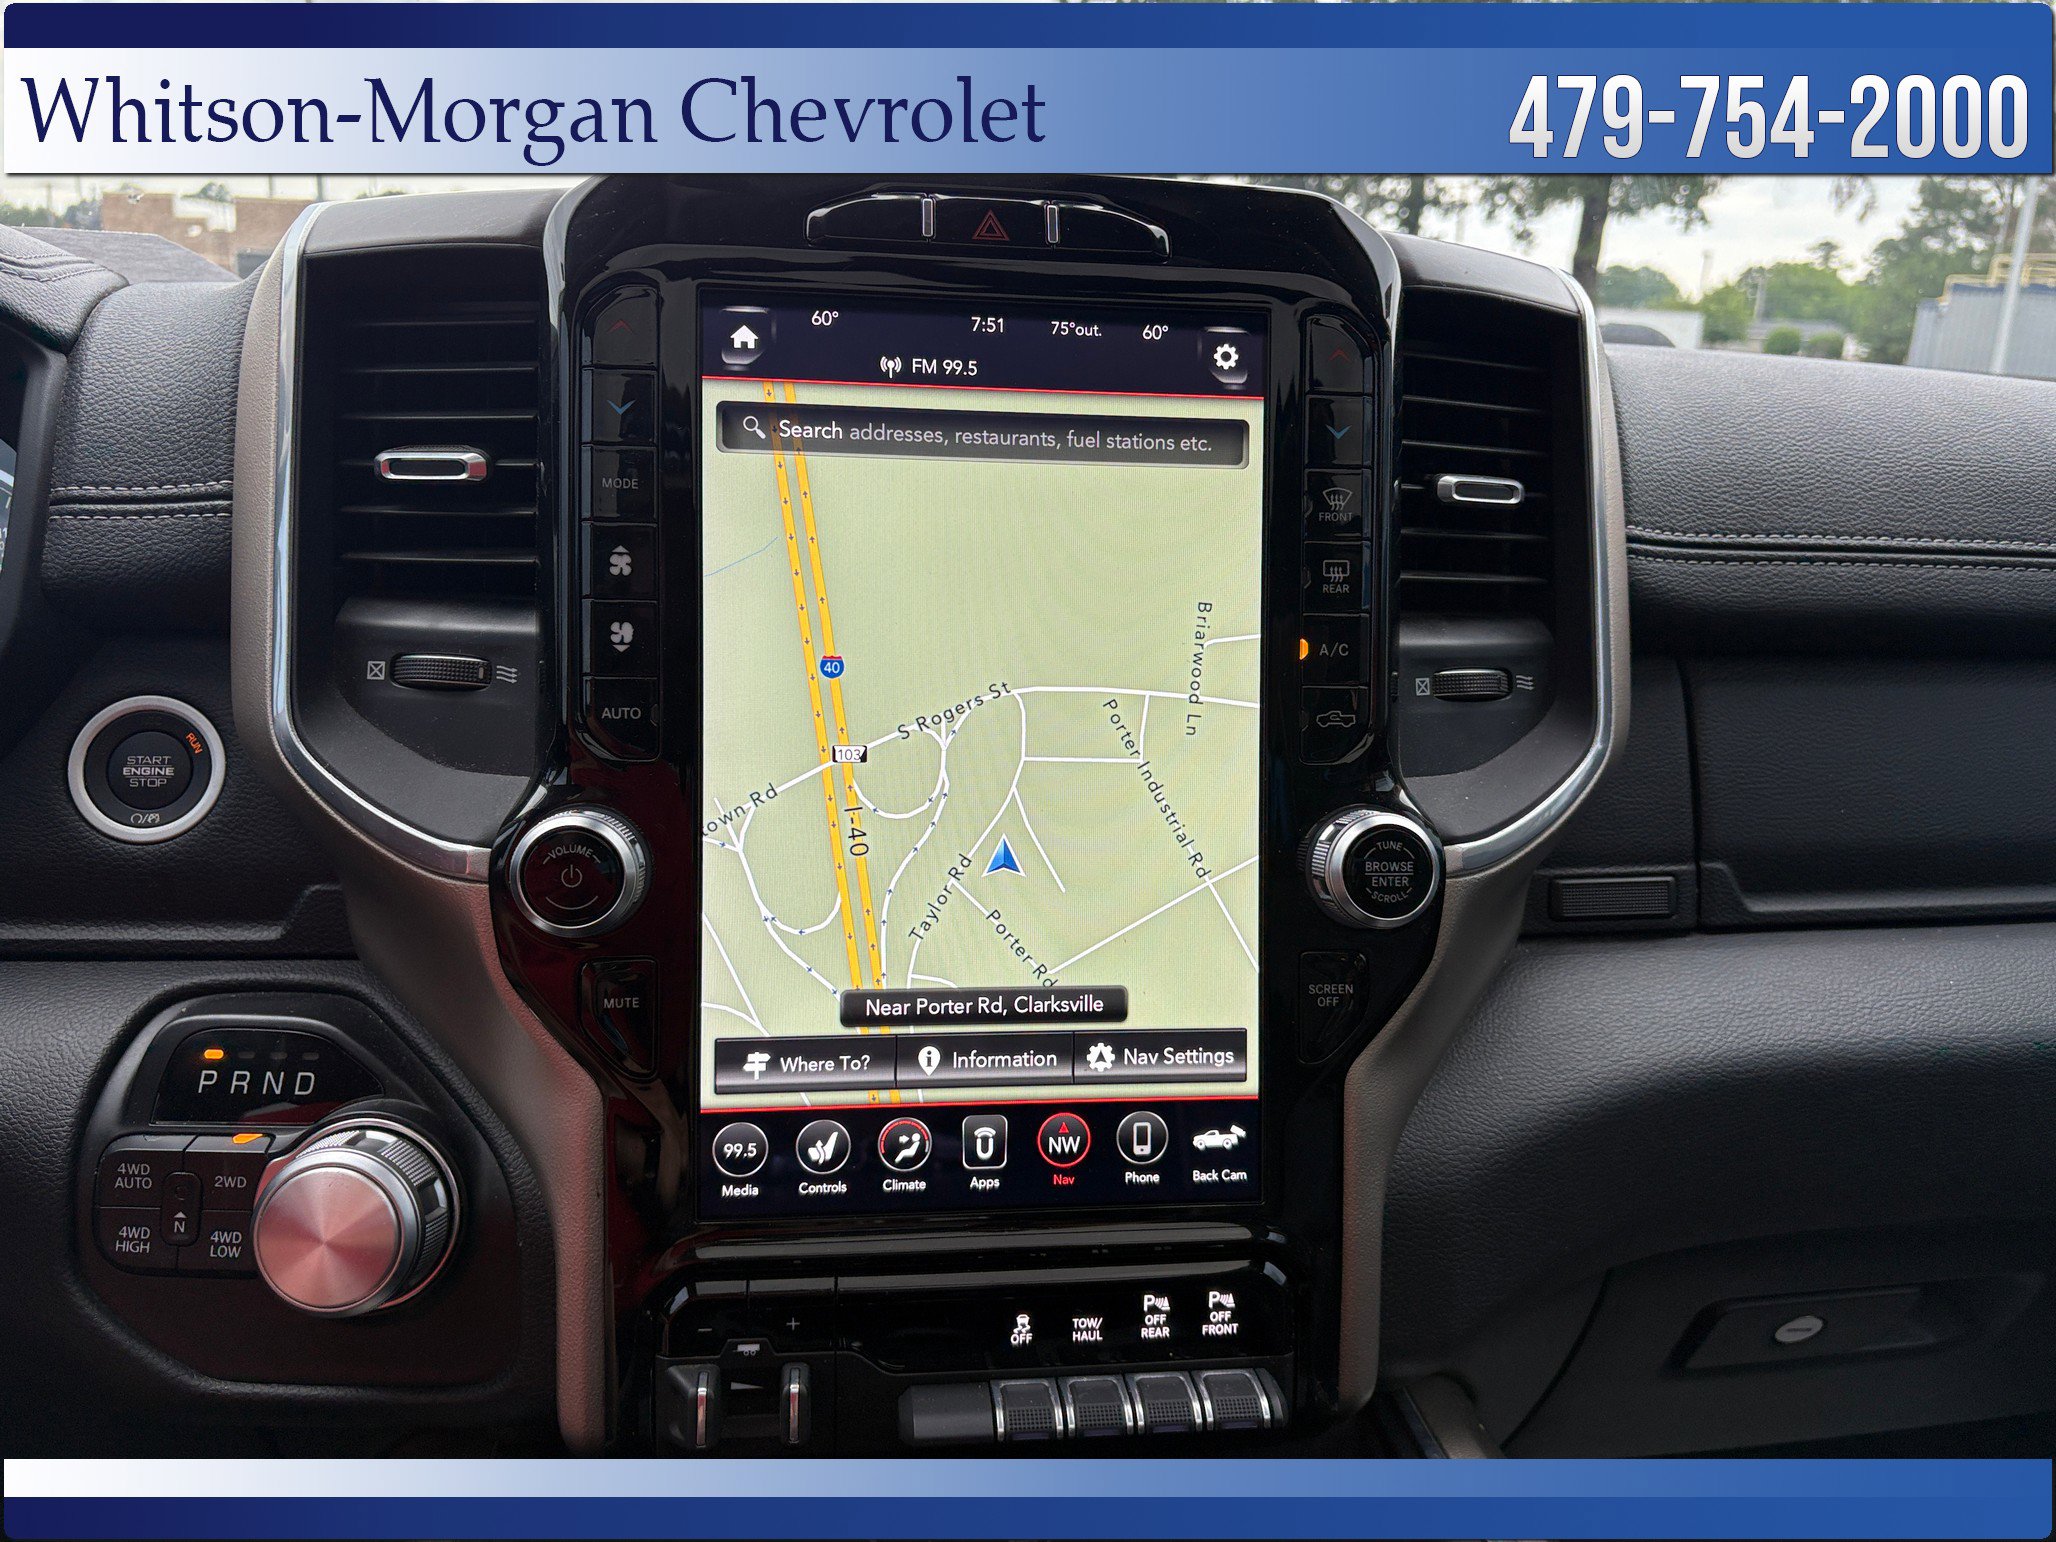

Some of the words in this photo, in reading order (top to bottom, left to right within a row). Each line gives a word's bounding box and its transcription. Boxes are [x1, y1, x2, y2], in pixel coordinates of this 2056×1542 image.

[971, 317, 1004, 333] 7:51
[912, 359, 937, 375] FM
[942, 361, 978, 377] 99.5
[778, 420, 843, 439] Search
[849, 424, 948, 446] addresses,
[955, 430, 1061, 448] restaurants,
[1067, 430, 1100, 450] fuel
[1106, 434, 1175, 452] stations
[1180, 437, 1212, 453] etc.
[602, 477, 638, 490] MODE
[1318, 511, 1353, 522] FRONT
[1322, 583, 1350, 594] REAR
[1188, 601, 1213, 704] Briarwood
[1319, 643, 1349, 657] A/C
[823, 662, 841, 674] 40
[601, 707, 642, 720] AUTO
[897, 724, 910, 740] S
[915, 694, 984, 732] Rogers
[988, 681, 1012, 699] St
[1185, 713, 1202, 736] Ln
[185, 732, 203, 754] RUN
[127, 755, 171, 765] START
[837, 748, 861, 761] 103
[123, 766, 175, 776] ENGINE
[129, 778, 167, 788] STOP
[1102, 698, 1141, 757] Porter
[1137, 761, 1195, 849] Industrial
[1188, 852, 1212, 879] Rd
[749, 782, 778, 808] Rd
[844, 806, 870, 857] I-40
[548, 844, 593, 859] VOLUME
[1376, 840, 1403, 851] TUNE
[1365, 861, 1414, 872] BROWSE
[1371, 876, 1409, 887] ENTER
[908, 884, 953, 940] Taylor
[948, 853, 972, 881] Rd
[1371, 890, 1409, 903] SCROLL
[985, 909, 1033, 963] Porter
[1032, 963, 1059, 987] Rd
[1308, 983, 1354, 995] SCREEN
[603, 997, 640, 1008] MUTE
[865, 998, 912, 1016] Near
[914, 997, 974, 1016] Porter
[978, 996, 1008, 1016] Rd,
[1013, 993, 1105, 1015] Clarksville
[1317, 997, 1340, 1007] OFF
[780, 1056, 835, 1072] Where
[840, 1054, 871, 1071] To?
[952, 1049, 1058, 1069] Information
[1123, 1048, 1160, 1065] Nav
[1161, 1046, 1235, 1067] Settings
[722, 1142, 757, 1159] 99.5
[1047, 1136, 1081, 1155] NW
[117, 1163, 151, 1175] 4WD
[1192, 1169, 1219, 1182] Back
[1221, 1169, 1248, 1183] Cam
[114, 1177, 153, 1190] AUTO
[214, 1176, 247, 1189] 2WD
[969, 1177, 1000, 1192] Apps
[1052, 1174, 1075, 1186] Nav
[1124, 1171, 1161, 1185] Phone
[721, 1184, 759, 1198] Media
[798, 1181, 848, 1195] Controls
[882, 1179, 927, 1194] Climate
[118, 1226, 151, 1239] 4WD
[173, 1221, 186, 1234] N
[210, 1230, 243, 1243] 4WD
[115, 1240, 151, 1254] HIGH
[209, 1245, 242, 1259] LOW
[1072, 1317, 1103, 1331] TOW/
[1144, 1313, 1168, 1327] OFF
[1209, 1310, 1232, 1324] OFF
[1072, 1330, 1104, 1343] HAUL
[1141, 1327, 1171, 1339] REAR
[1202, 1323, 1239, 1337] FRONT
[1010, 1332, 1034, 1346] OFF
